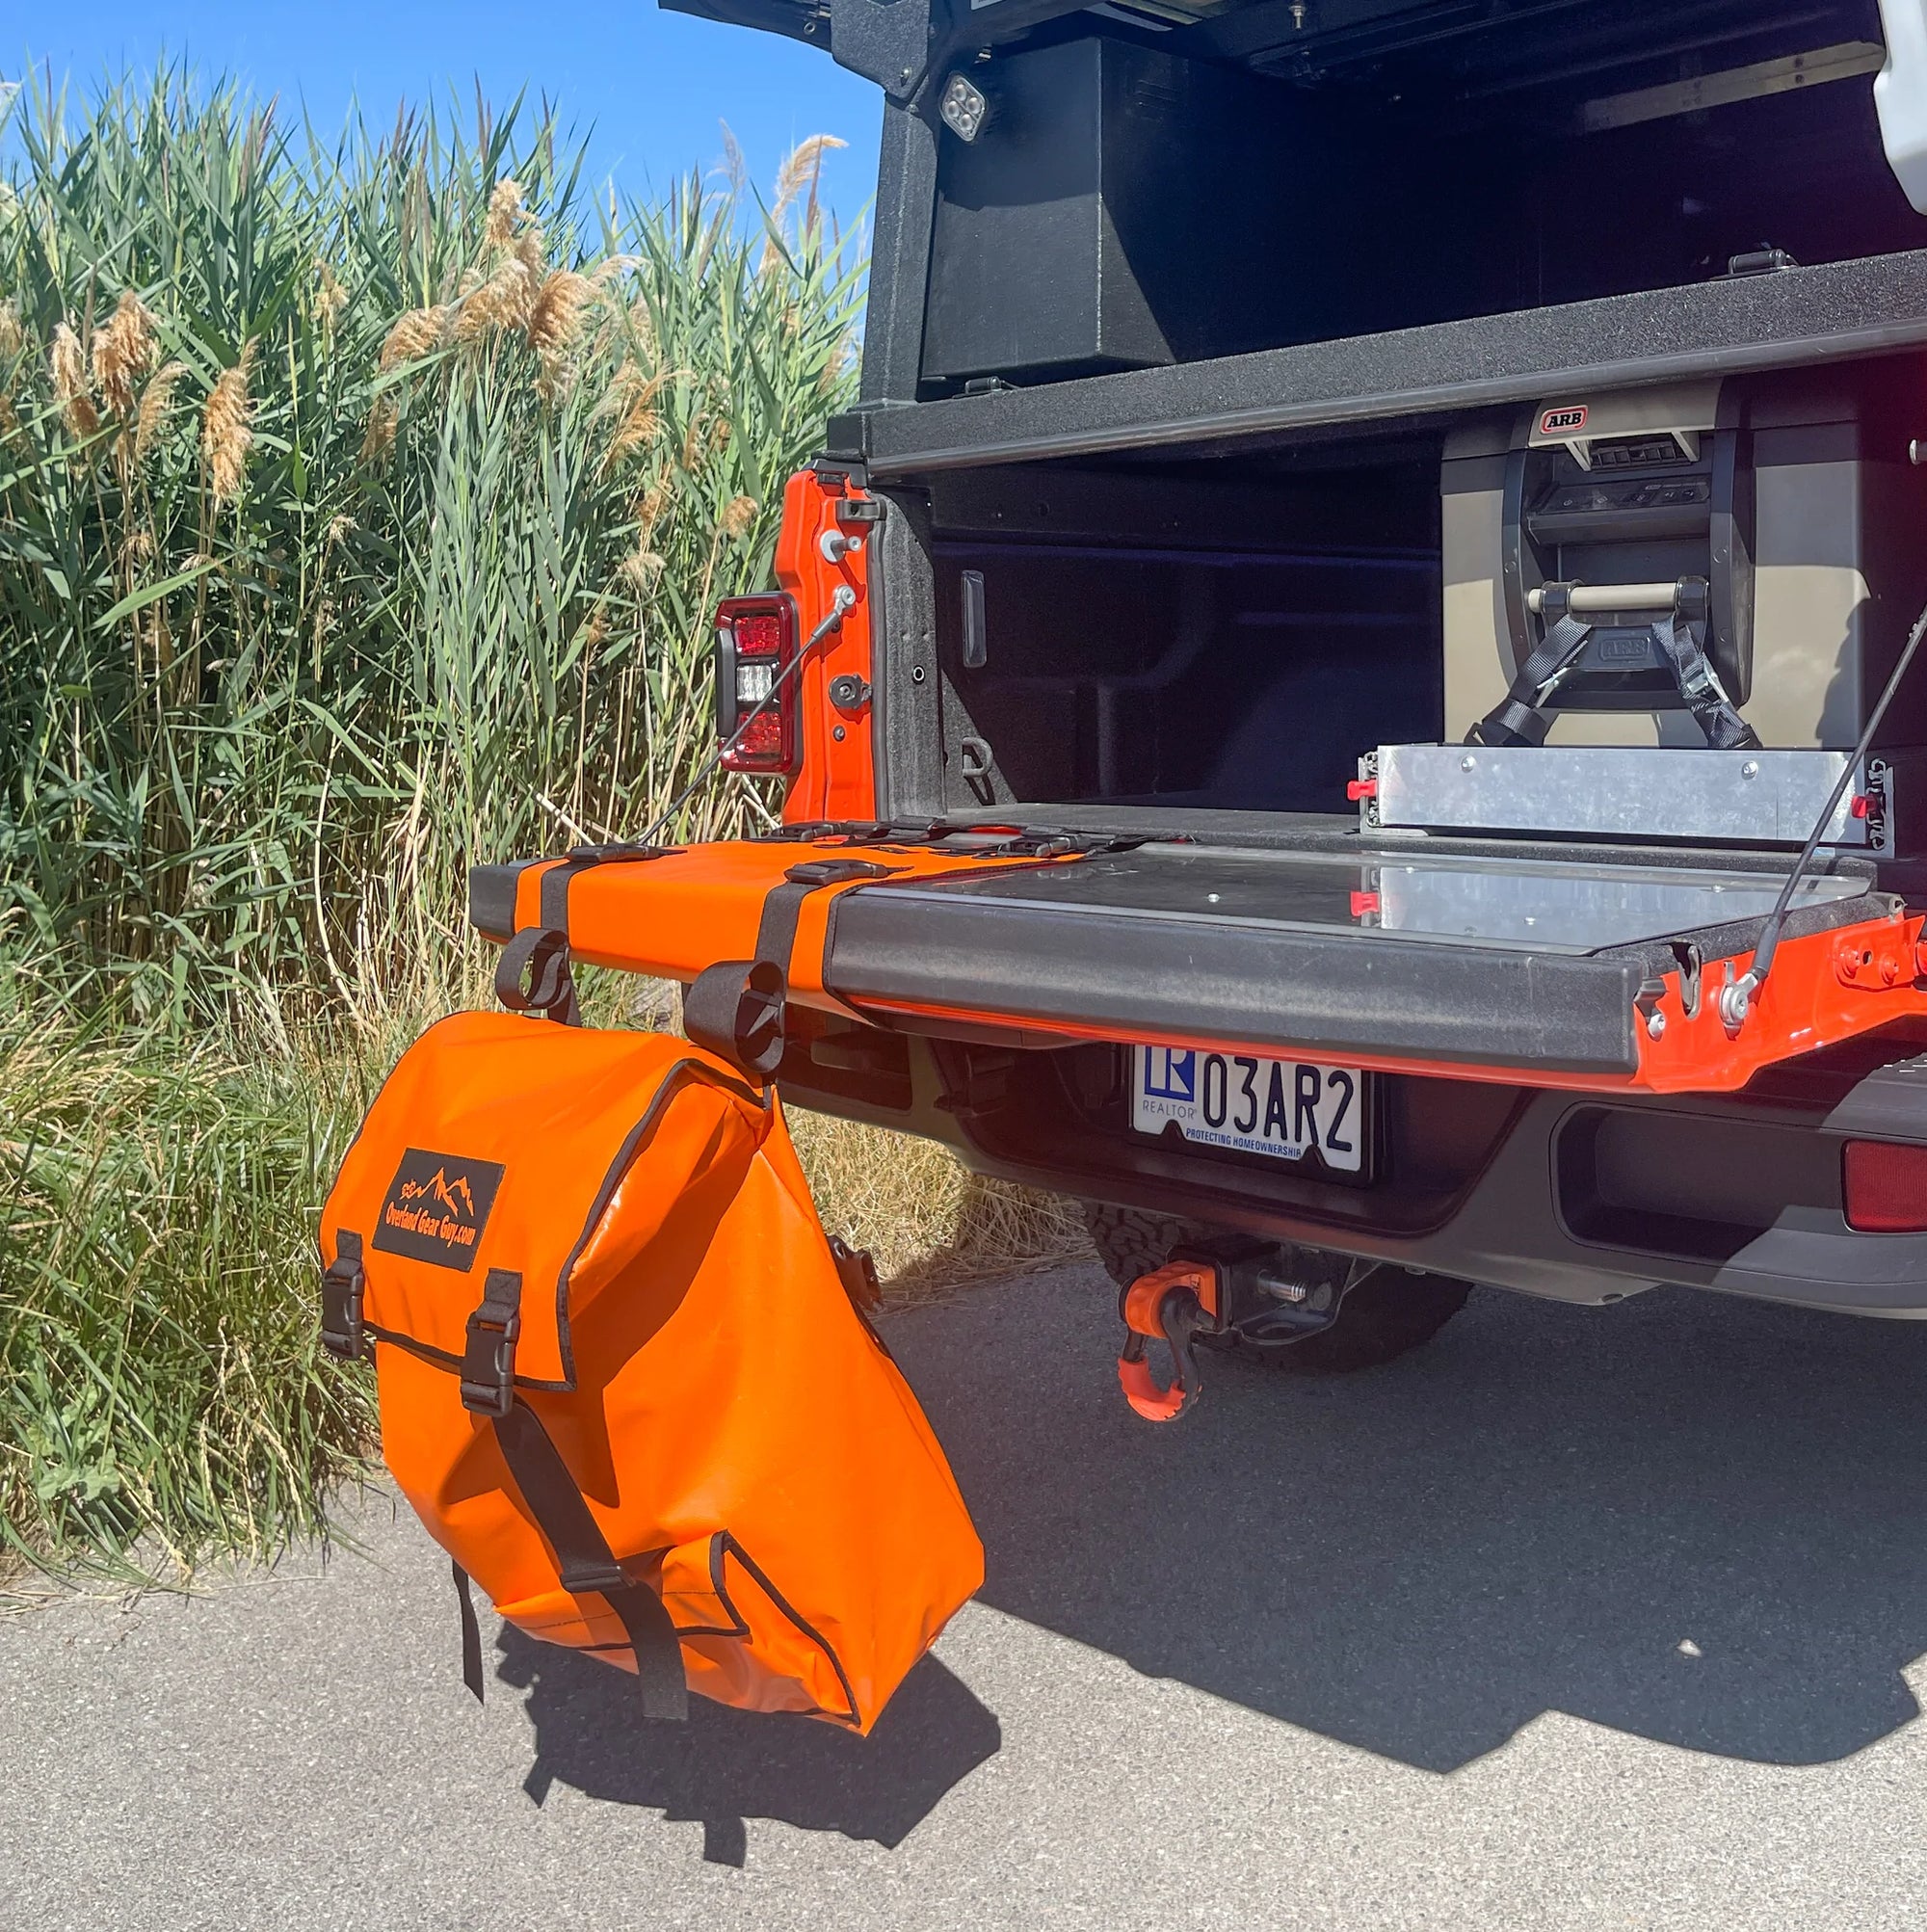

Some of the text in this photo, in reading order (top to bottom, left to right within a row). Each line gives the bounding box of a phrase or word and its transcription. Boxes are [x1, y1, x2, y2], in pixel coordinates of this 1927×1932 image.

[1546, 412, 1582, 428] ARB
[1203, 1053, 1354, 1151] 03AR2
[1186, 1127, 1302, 1157] PROTECTING HOMEOWNERSHIP
[386, 1201, 476, 1248] Overland Gear Guy.com
